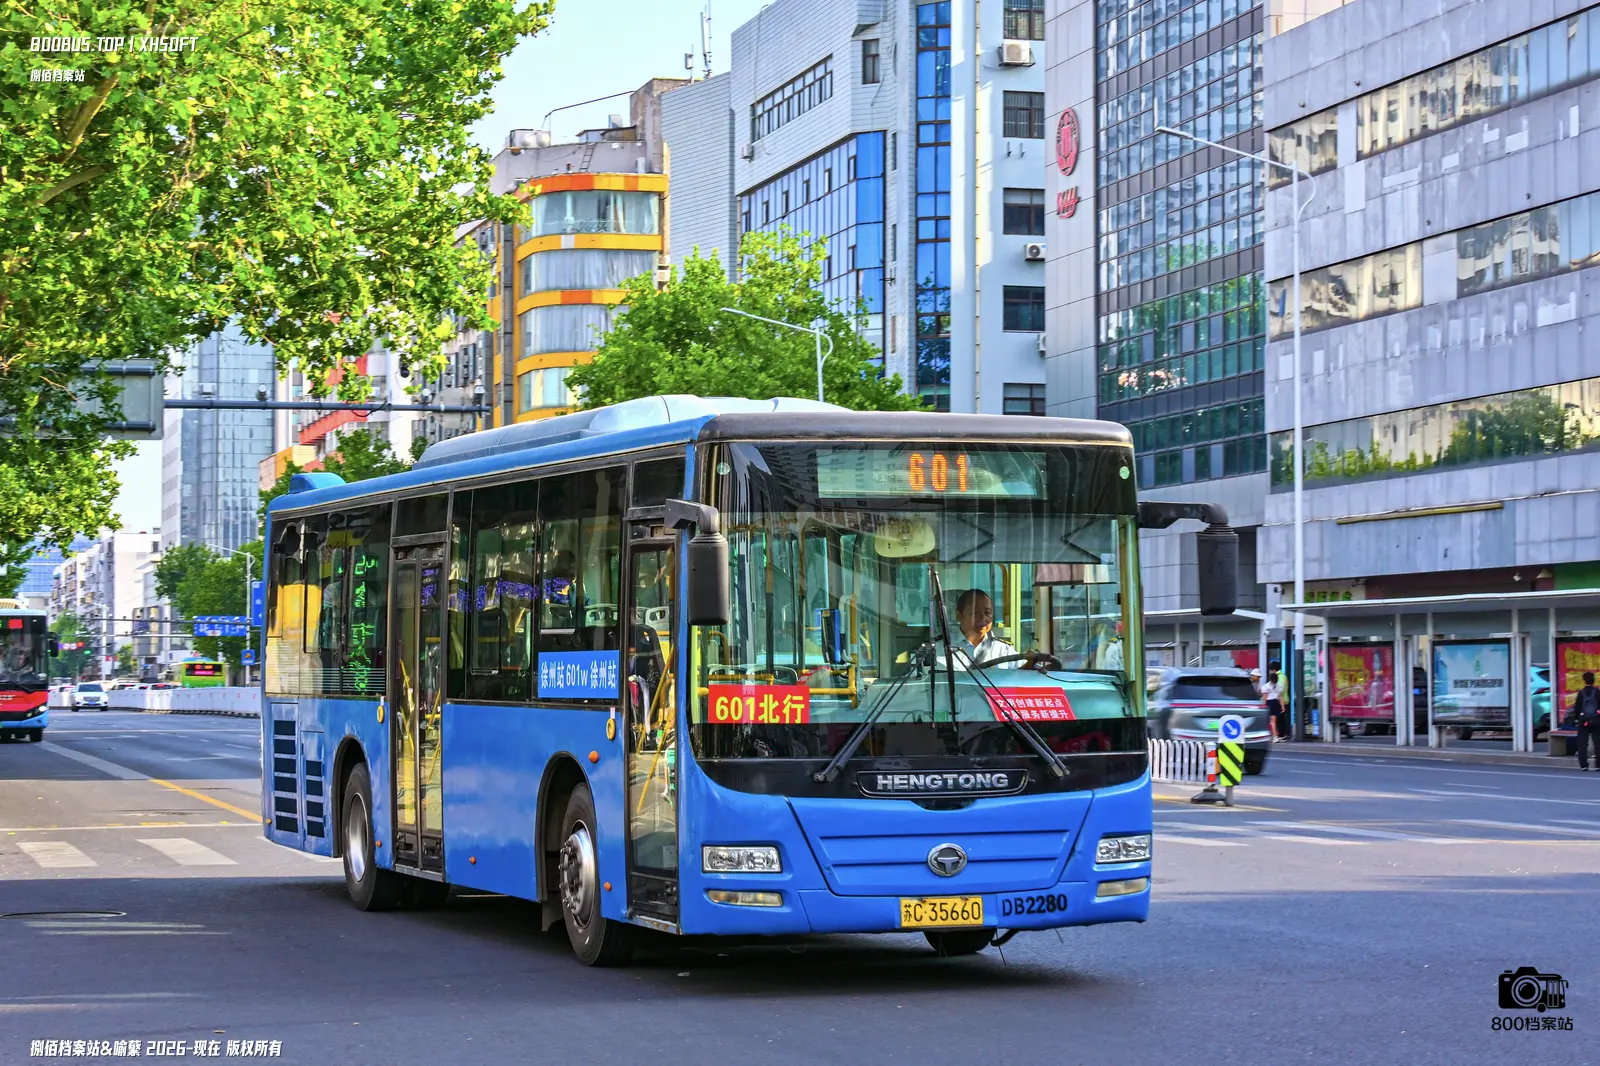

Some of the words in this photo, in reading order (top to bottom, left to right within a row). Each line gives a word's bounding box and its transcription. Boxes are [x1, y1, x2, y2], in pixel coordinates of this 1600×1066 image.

[909, 453, 967, 492] 601
[541, 661, 564, 689] 徐州站
[566, 663, 589, 687] 601w
[590, 660, 616, 689] 徐州站
[715, 693, 805, 724] 601北行
[995, 698, 1064, 708] 文明创建新起点
[876, 773, 1009, 791] HENGTONG
[1002, 894, 1067, 917] DB2280
